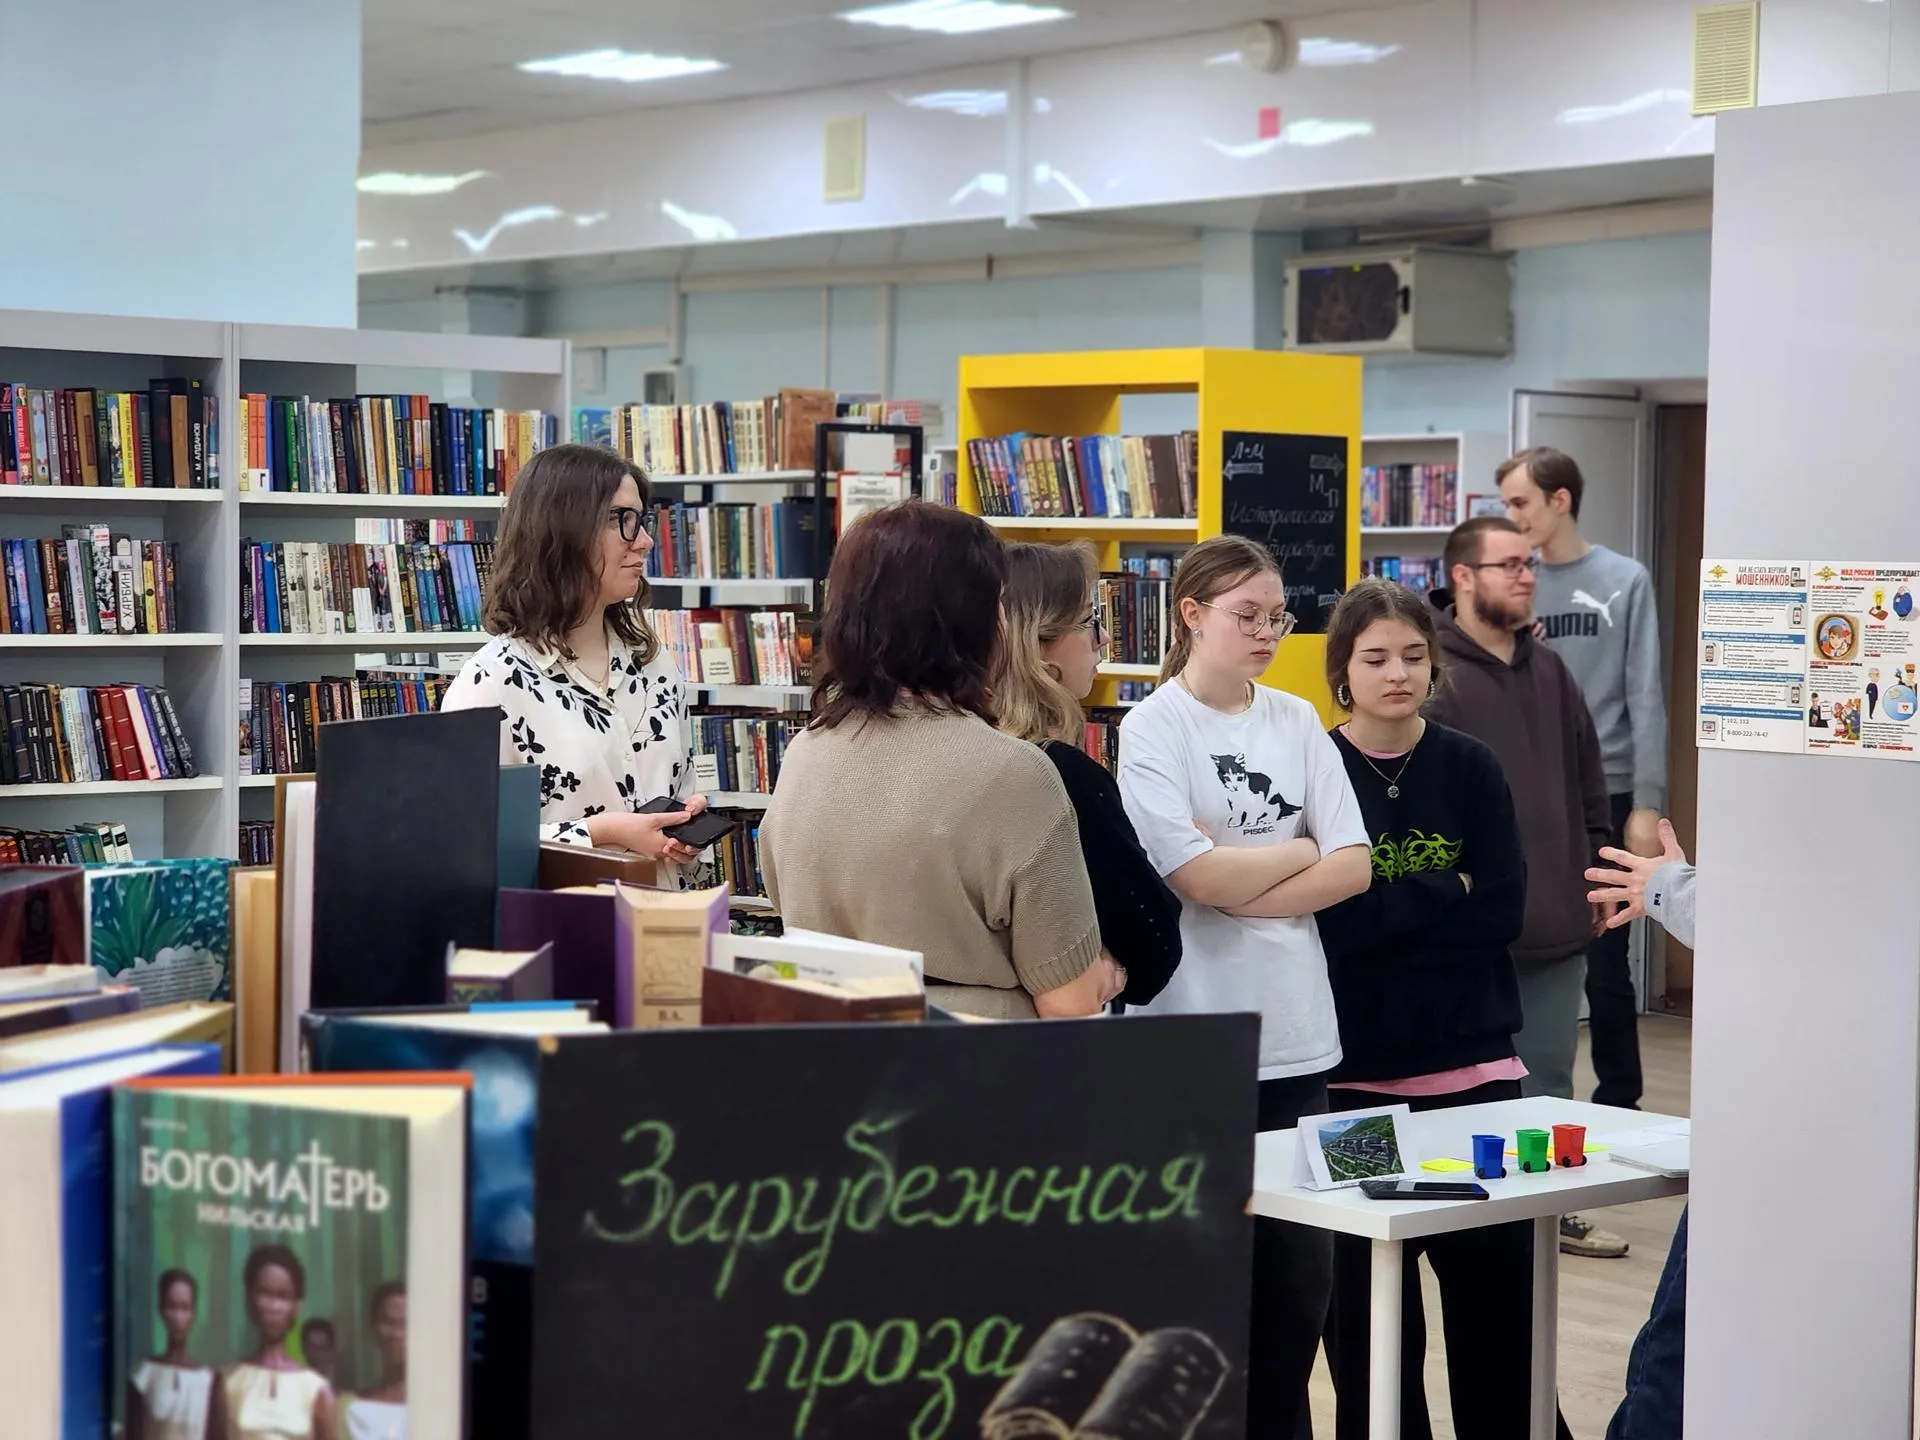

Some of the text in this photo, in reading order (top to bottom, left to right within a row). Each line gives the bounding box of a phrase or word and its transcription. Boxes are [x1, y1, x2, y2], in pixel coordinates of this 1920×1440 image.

[122, 572, 133, 618] ХАРБИН
[1736, 574, 1790, 586] МОШЕННИКОВ
[140, 1138, 391, 1228] БОГОМАТЕРЬ
[584, 1113, 1206, 1297] Зарубежная
[746, 1315, 1028, 1440] проза
